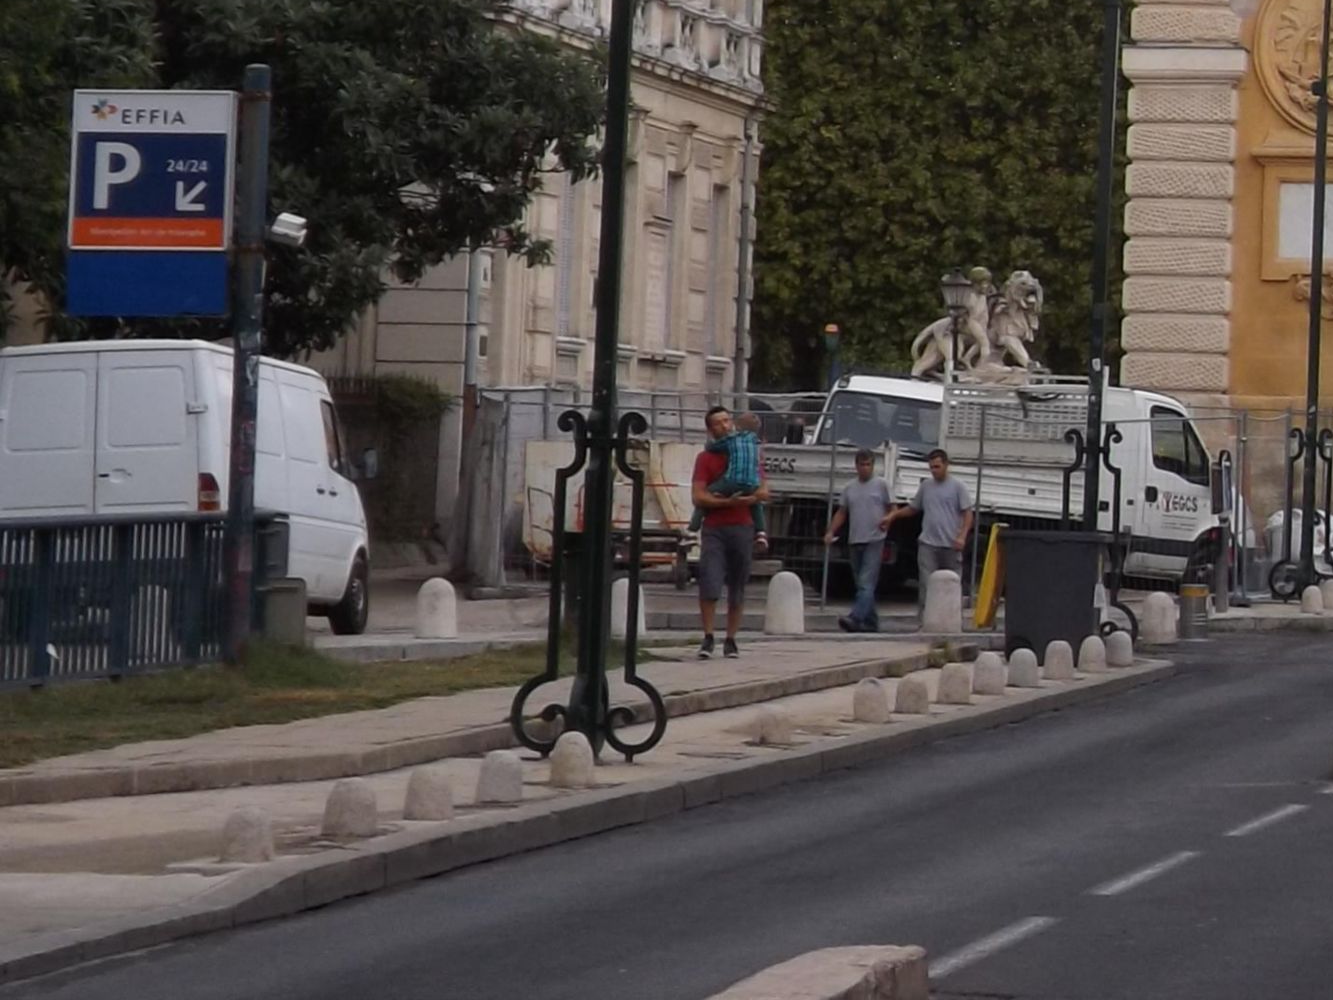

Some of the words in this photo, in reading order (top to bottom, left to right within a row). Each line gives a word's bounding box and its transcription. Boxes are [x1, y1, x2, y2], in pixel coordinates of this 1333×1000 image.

[121, 108, 186, 125] EFFIA
[167, 159, 209, 173] 24/24
[93, 141, 142, 210] P
